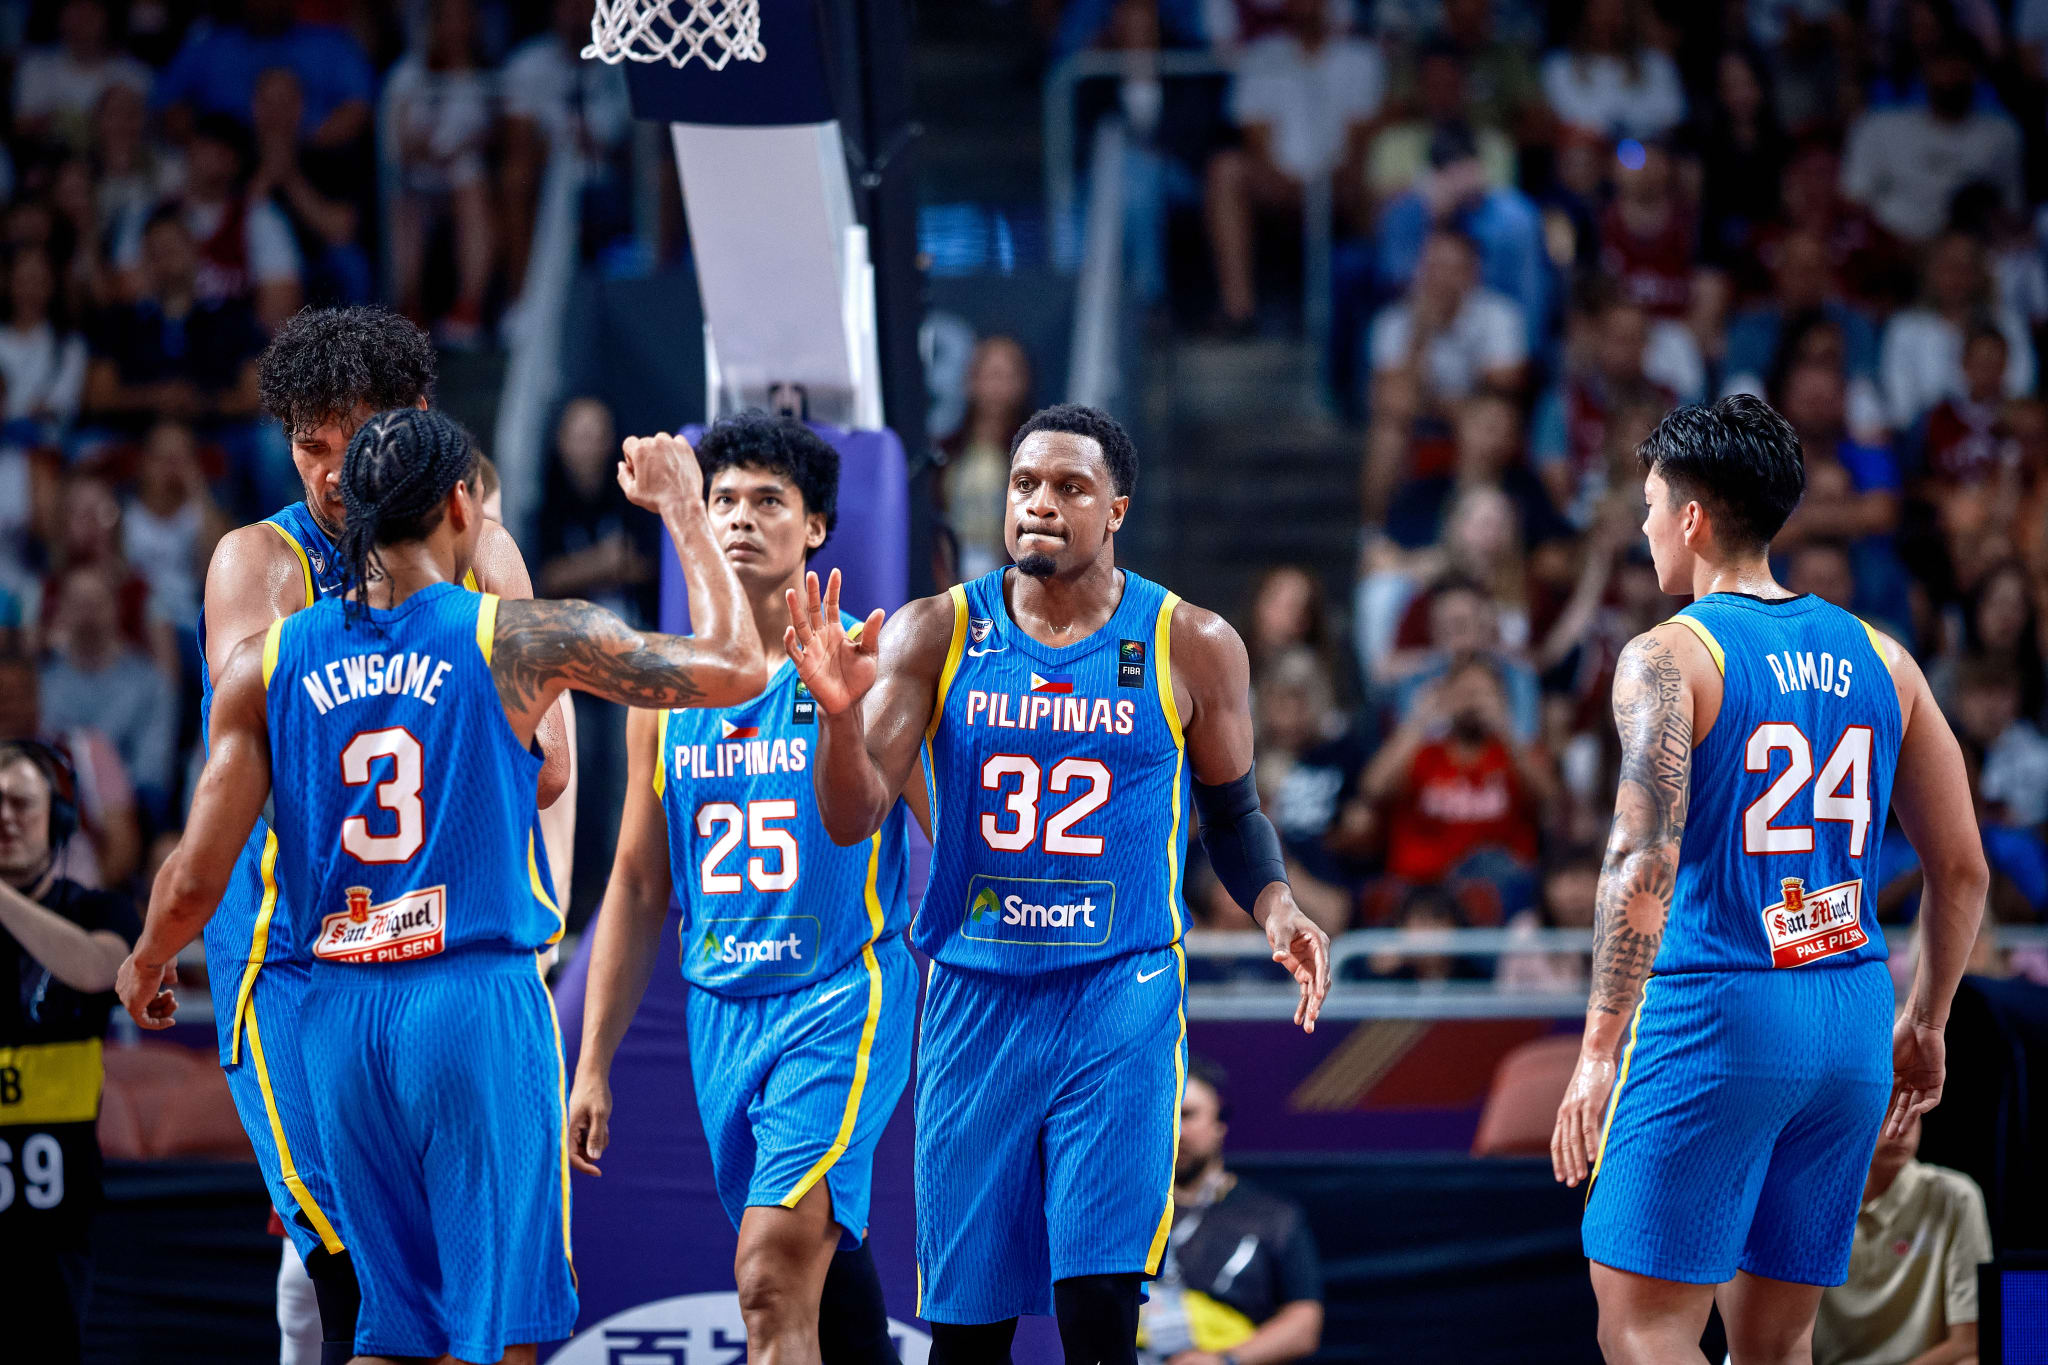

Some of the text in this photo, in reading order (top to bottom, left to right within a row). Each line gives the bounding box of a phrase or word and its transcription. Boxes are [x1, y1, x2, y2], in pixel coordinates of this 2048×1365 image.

[302, 652, 453, 716] NEWSOME
[1122, 666, 1141, 676] FIBA
[1766, 651, 1853, 698] RAMOS
[967, 690, 1135, 735] PILIPINAS
[675, 737, 807, 780] PILIPINAS
[339, 725, 426, 865] 3
[980, 752, 1113, 857] 32
[1742, 721, 1874, 859] 24
[694, 798, 799, 895] 25
[1002, 894, 1097, 928] Smart
[1773, 912, 1808, 937] San
[326, 922, 367, 946] San
[377, 938, 436, 962] PILSEN
[722, 932, 803, 963] Smart
[1796, 939, 1827, 958] PALE
